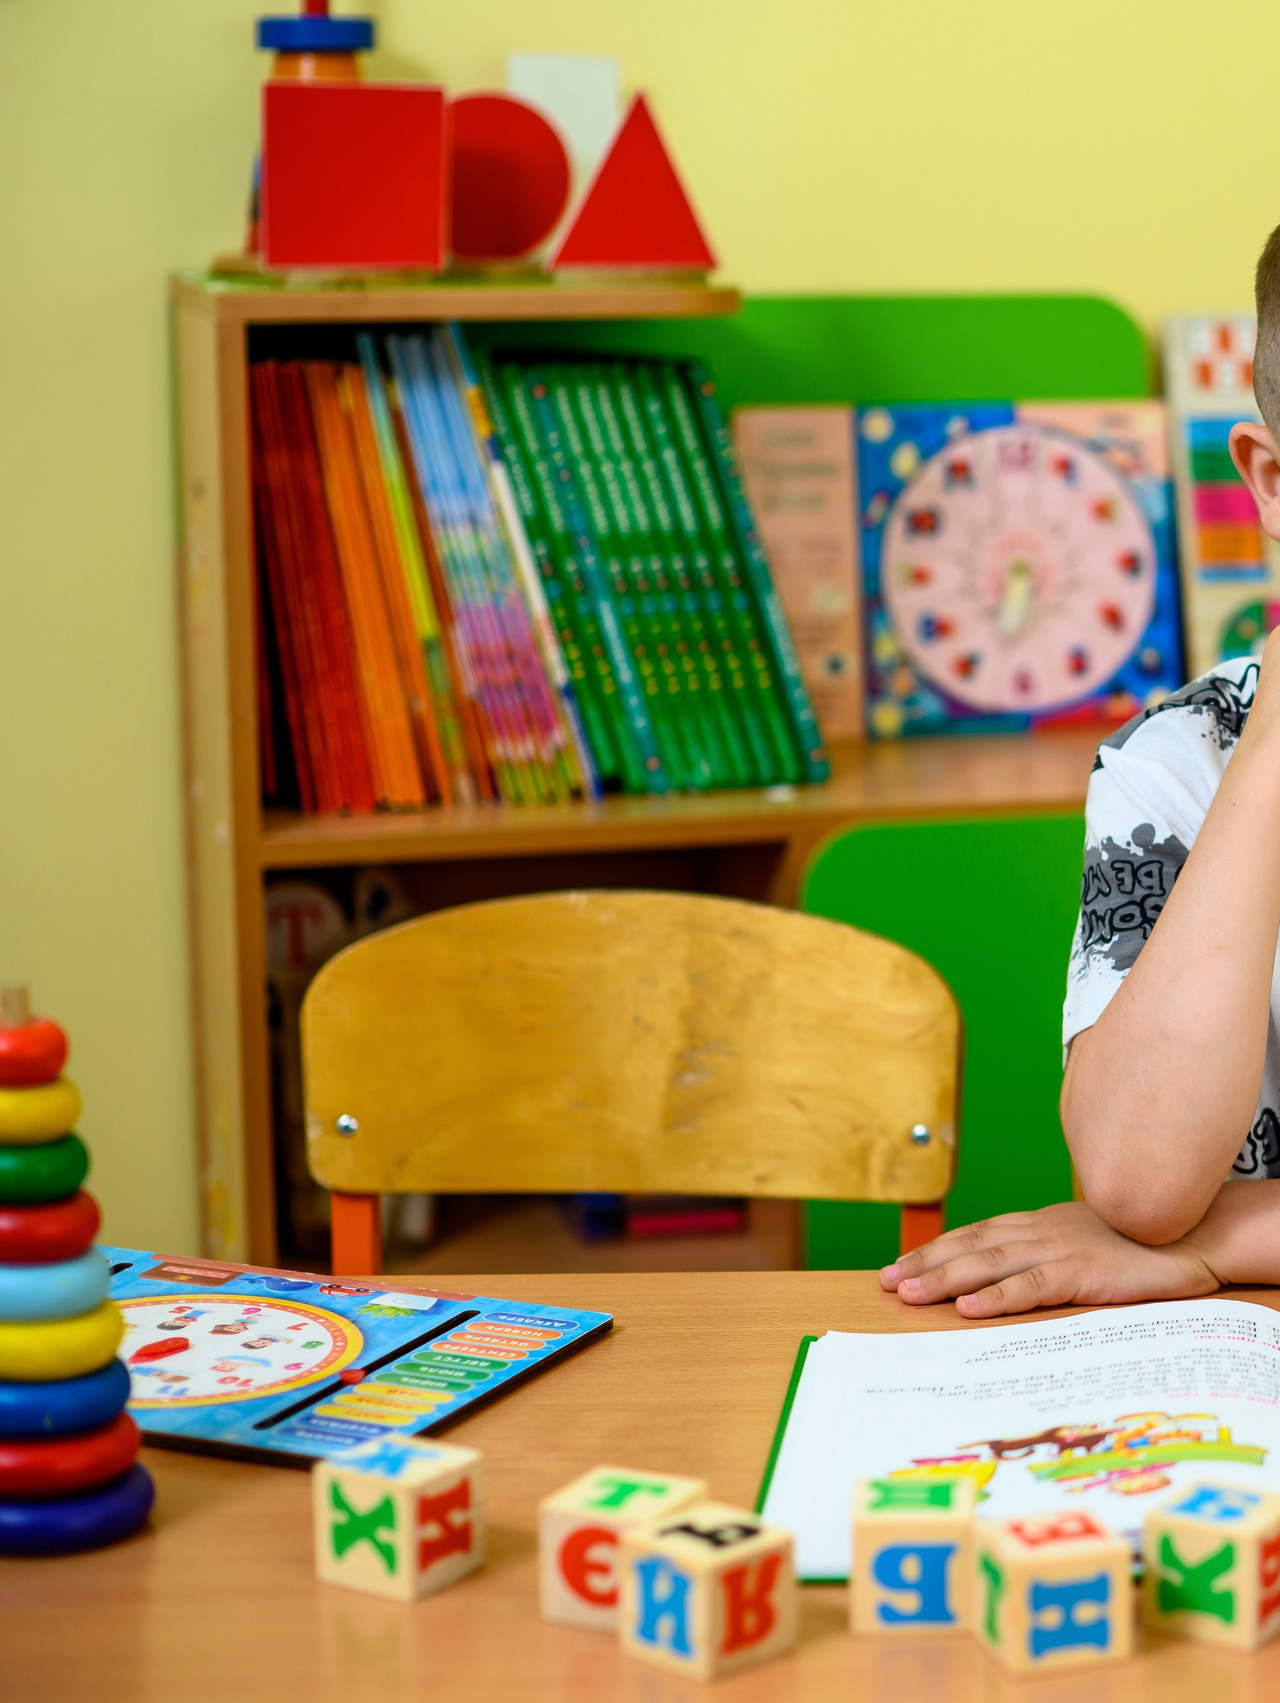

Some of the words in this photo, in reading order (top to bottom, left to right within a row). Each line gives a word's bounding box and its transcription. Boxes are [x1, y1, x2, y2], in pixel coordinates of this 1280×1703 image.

[498, 1315, 566, 1327] ДЕКАБРЬ
[486, 1325, 543, 1337] НОЯБРЬ
[465, 1334, 529, 1347] ОКТЯБРЬ
[442, 1344, 515, 1358] СЕНТЯБРЬ
[434, 1354, 490, 1368] АВГУСТ
[419, 1366, 465, 1377] ИЮЛЬ
[400, 1377, 447, 1389] ИЮНЬ
